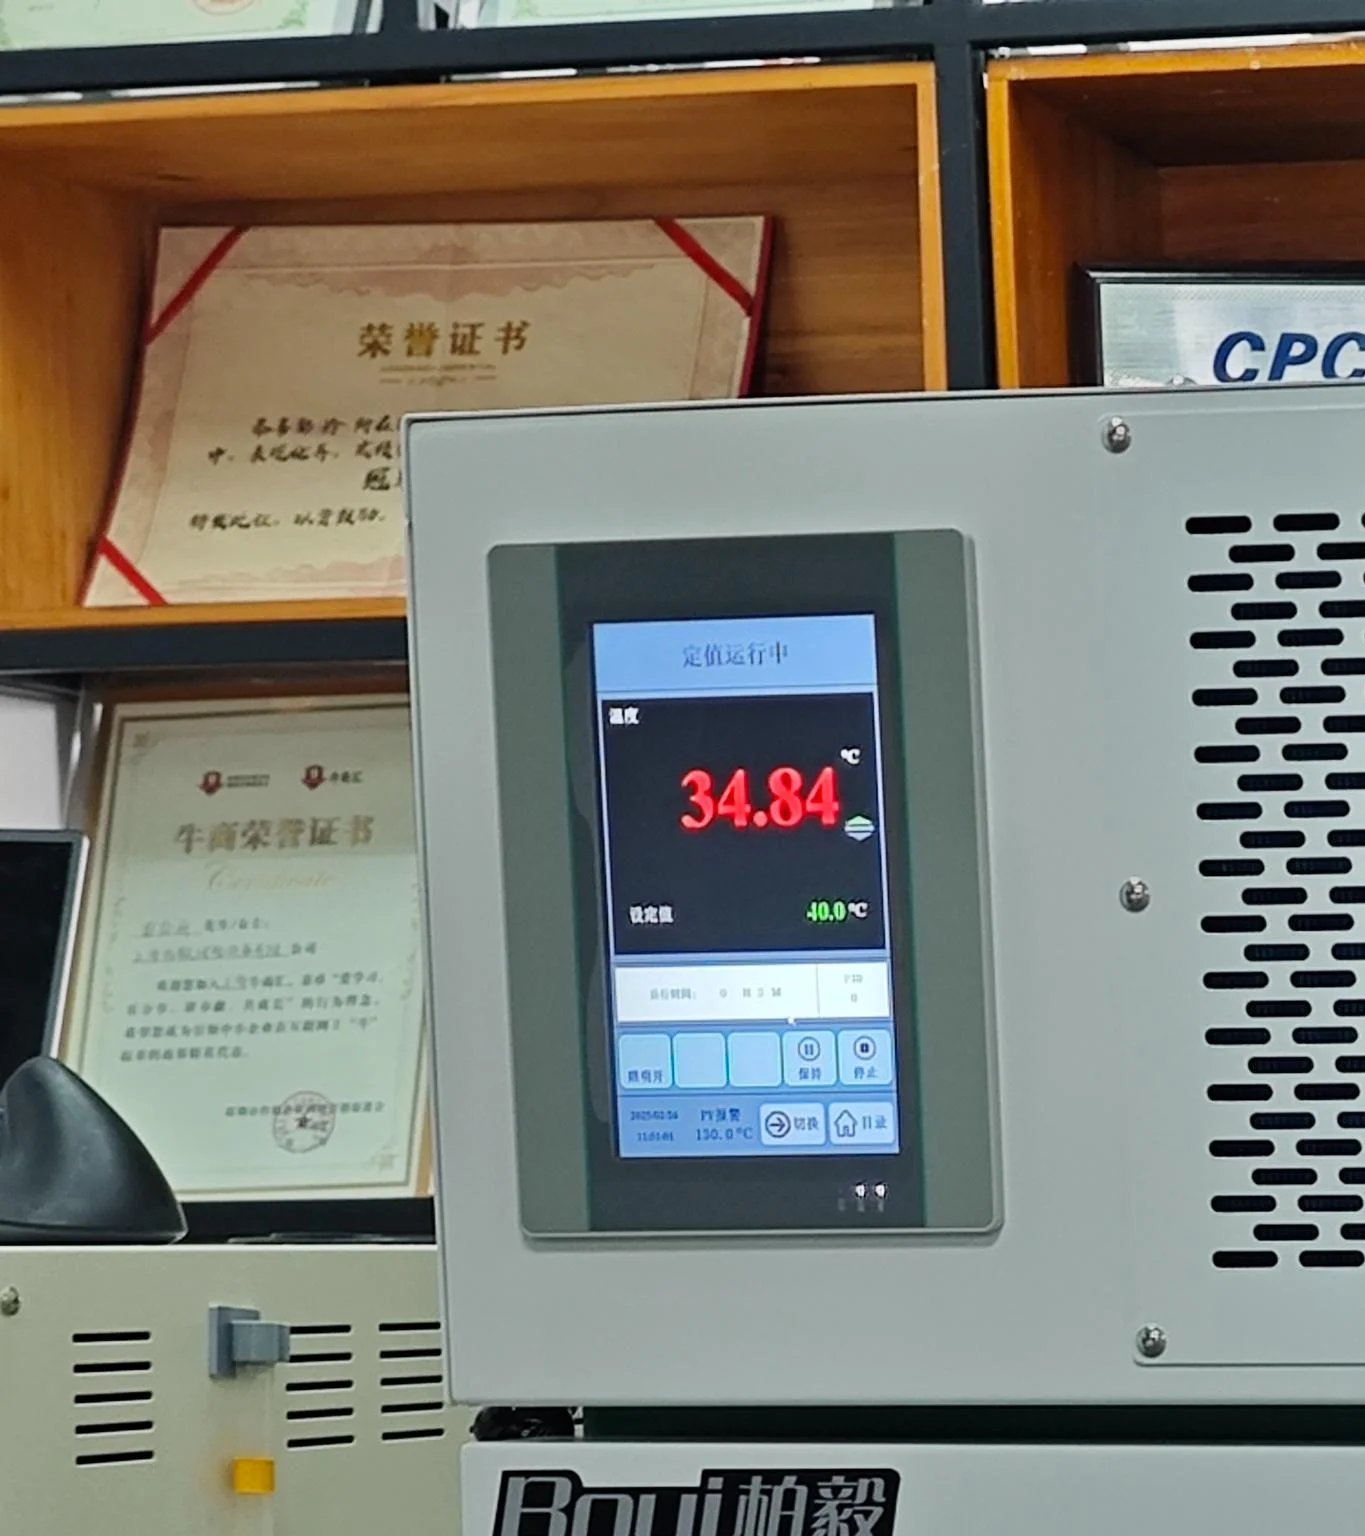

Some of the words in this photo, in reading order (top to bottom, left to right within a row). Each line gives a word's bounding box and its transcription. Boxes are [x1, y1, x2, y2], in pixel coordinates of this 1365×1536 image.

[357, 320, 532, 359] 荣誉证书
[682, 641, 789, 668] 定值运行中
[608, 706, 640, 725] 温度
[680, 766, 840, 830] 34.84
[173, 815, 376, 856] 牛商荣誉证书
[629, 905, 673, 924] 设定值
[798, 1066, 822, 1081] 保持
[853, 1066, 879, 1080] 停止
[793, 1115, 820, 1130] 切换
